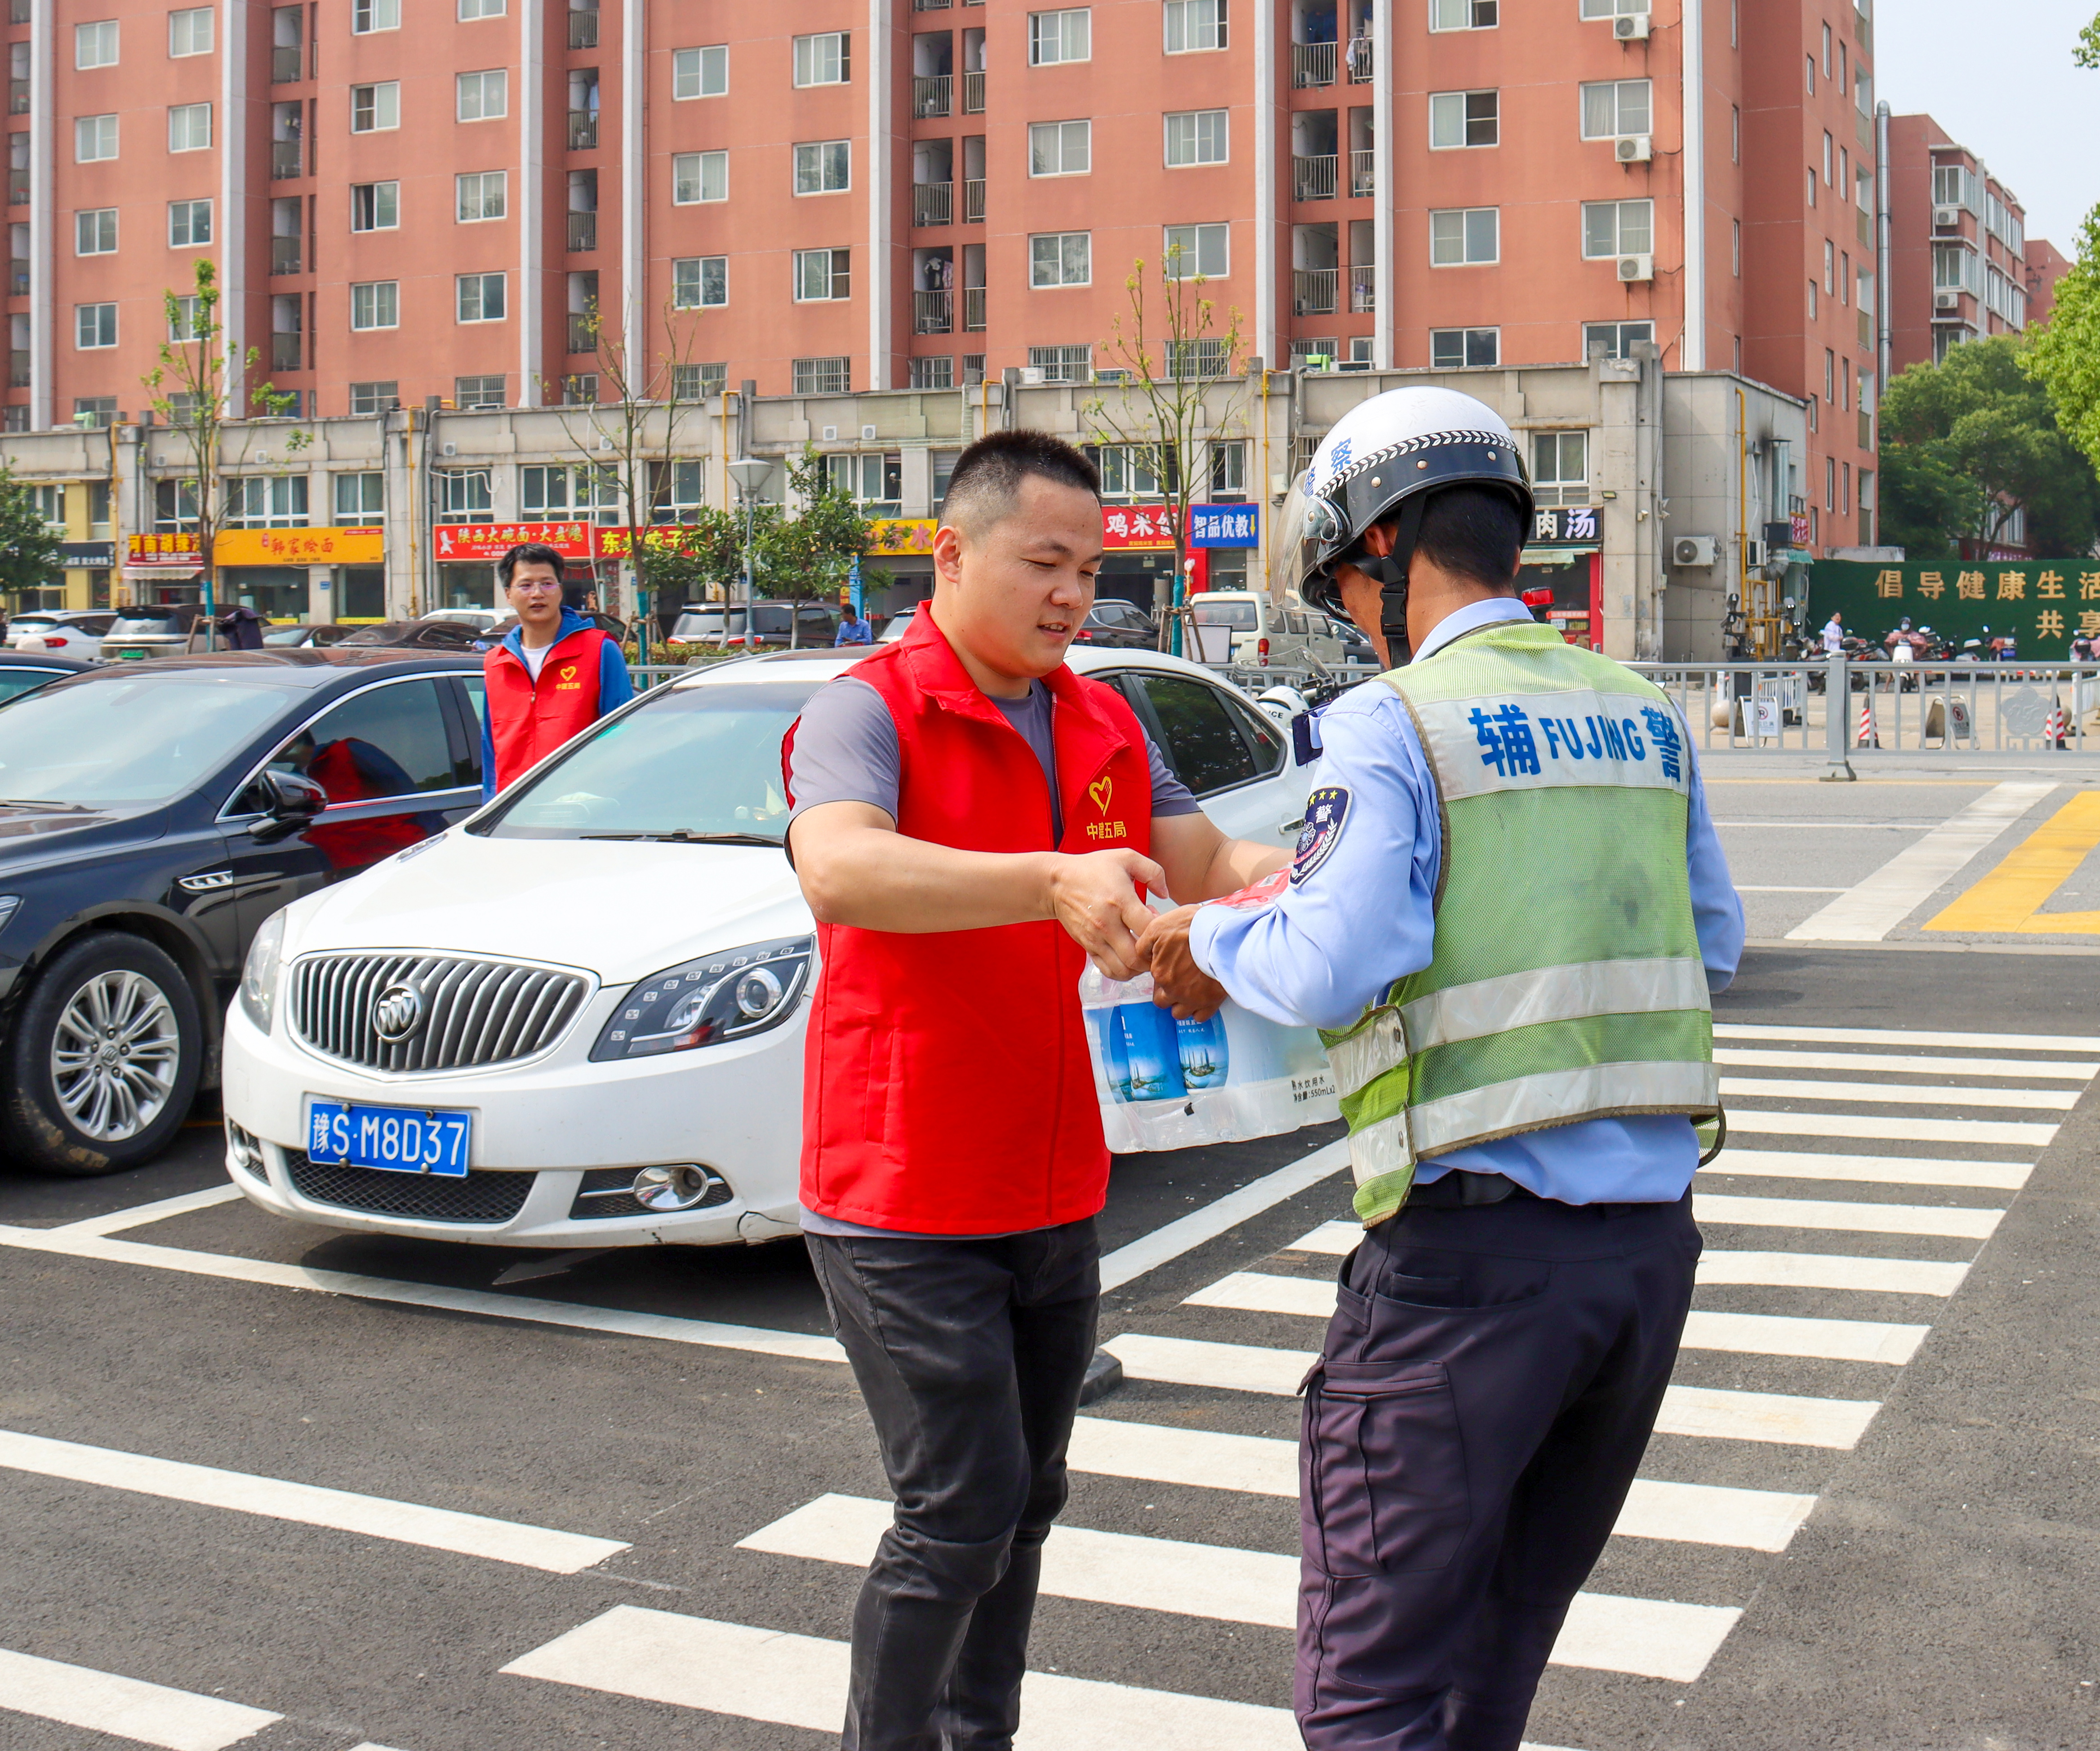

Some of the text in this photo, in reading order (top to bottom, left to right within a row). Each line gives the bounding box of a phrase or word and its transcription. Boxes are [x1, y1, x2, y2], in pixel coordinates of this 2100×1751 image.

[1194, 514, 1249, 538] 智品优教
[1536, 508, 1595, 539] 肉汤
[1875, 570, 2100, 600] 倡导健康生活
[1468, 703, 1681, 782] 辅 FUJING 警
[1316, 803, 1333, 824] 警
[312, 1112, 465, 1166] 豫S·M8D37
